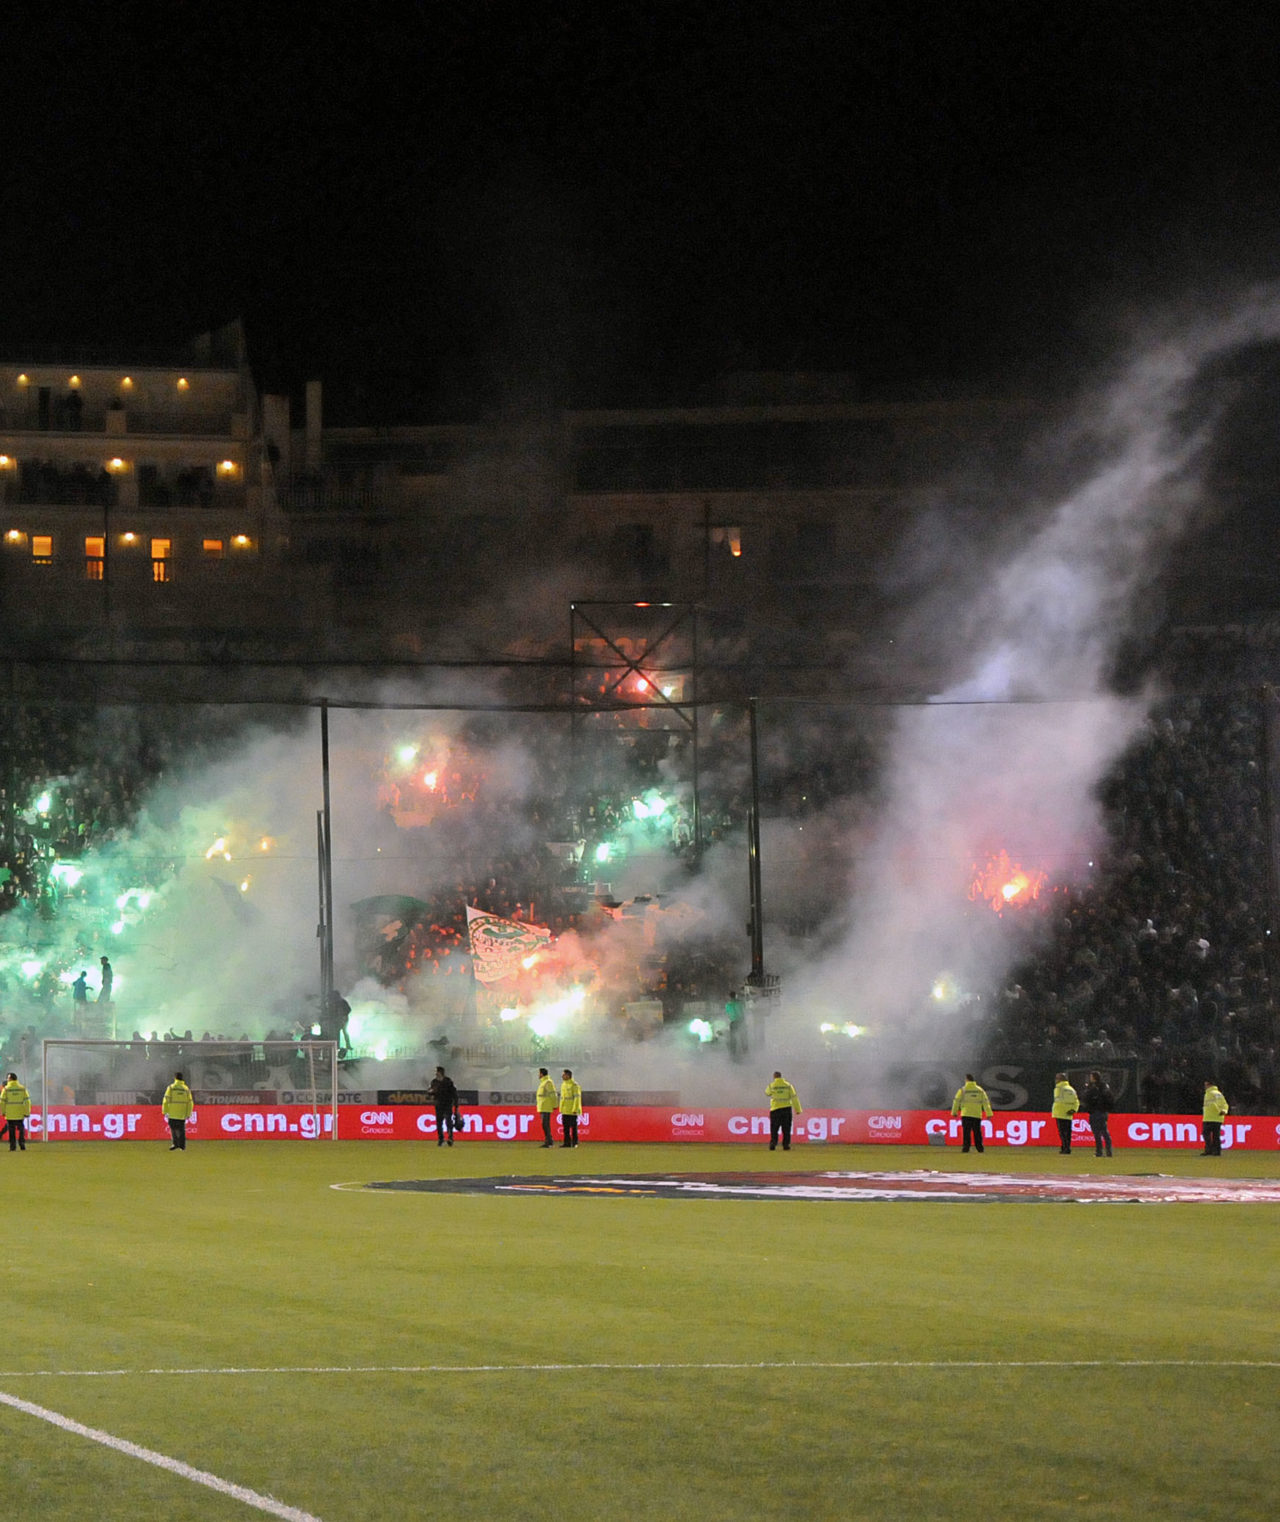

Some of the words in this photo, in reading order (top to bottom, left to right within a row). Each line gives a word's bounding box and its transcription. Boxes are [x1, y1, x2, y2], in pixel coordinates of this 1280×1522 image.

[24, 1112, 142, 1138] cnn.gr
[221, 1112, 338, 1138] cnn.gr
[360, 1111, 393, 1124] CNN
[417, 1113, 534, 1139] cn.gr
[671, 1113, 704, 1126] CNN
[728, 1115, 846, 1140] cn.gr
[868, 1116, 902, 1129] CNN
